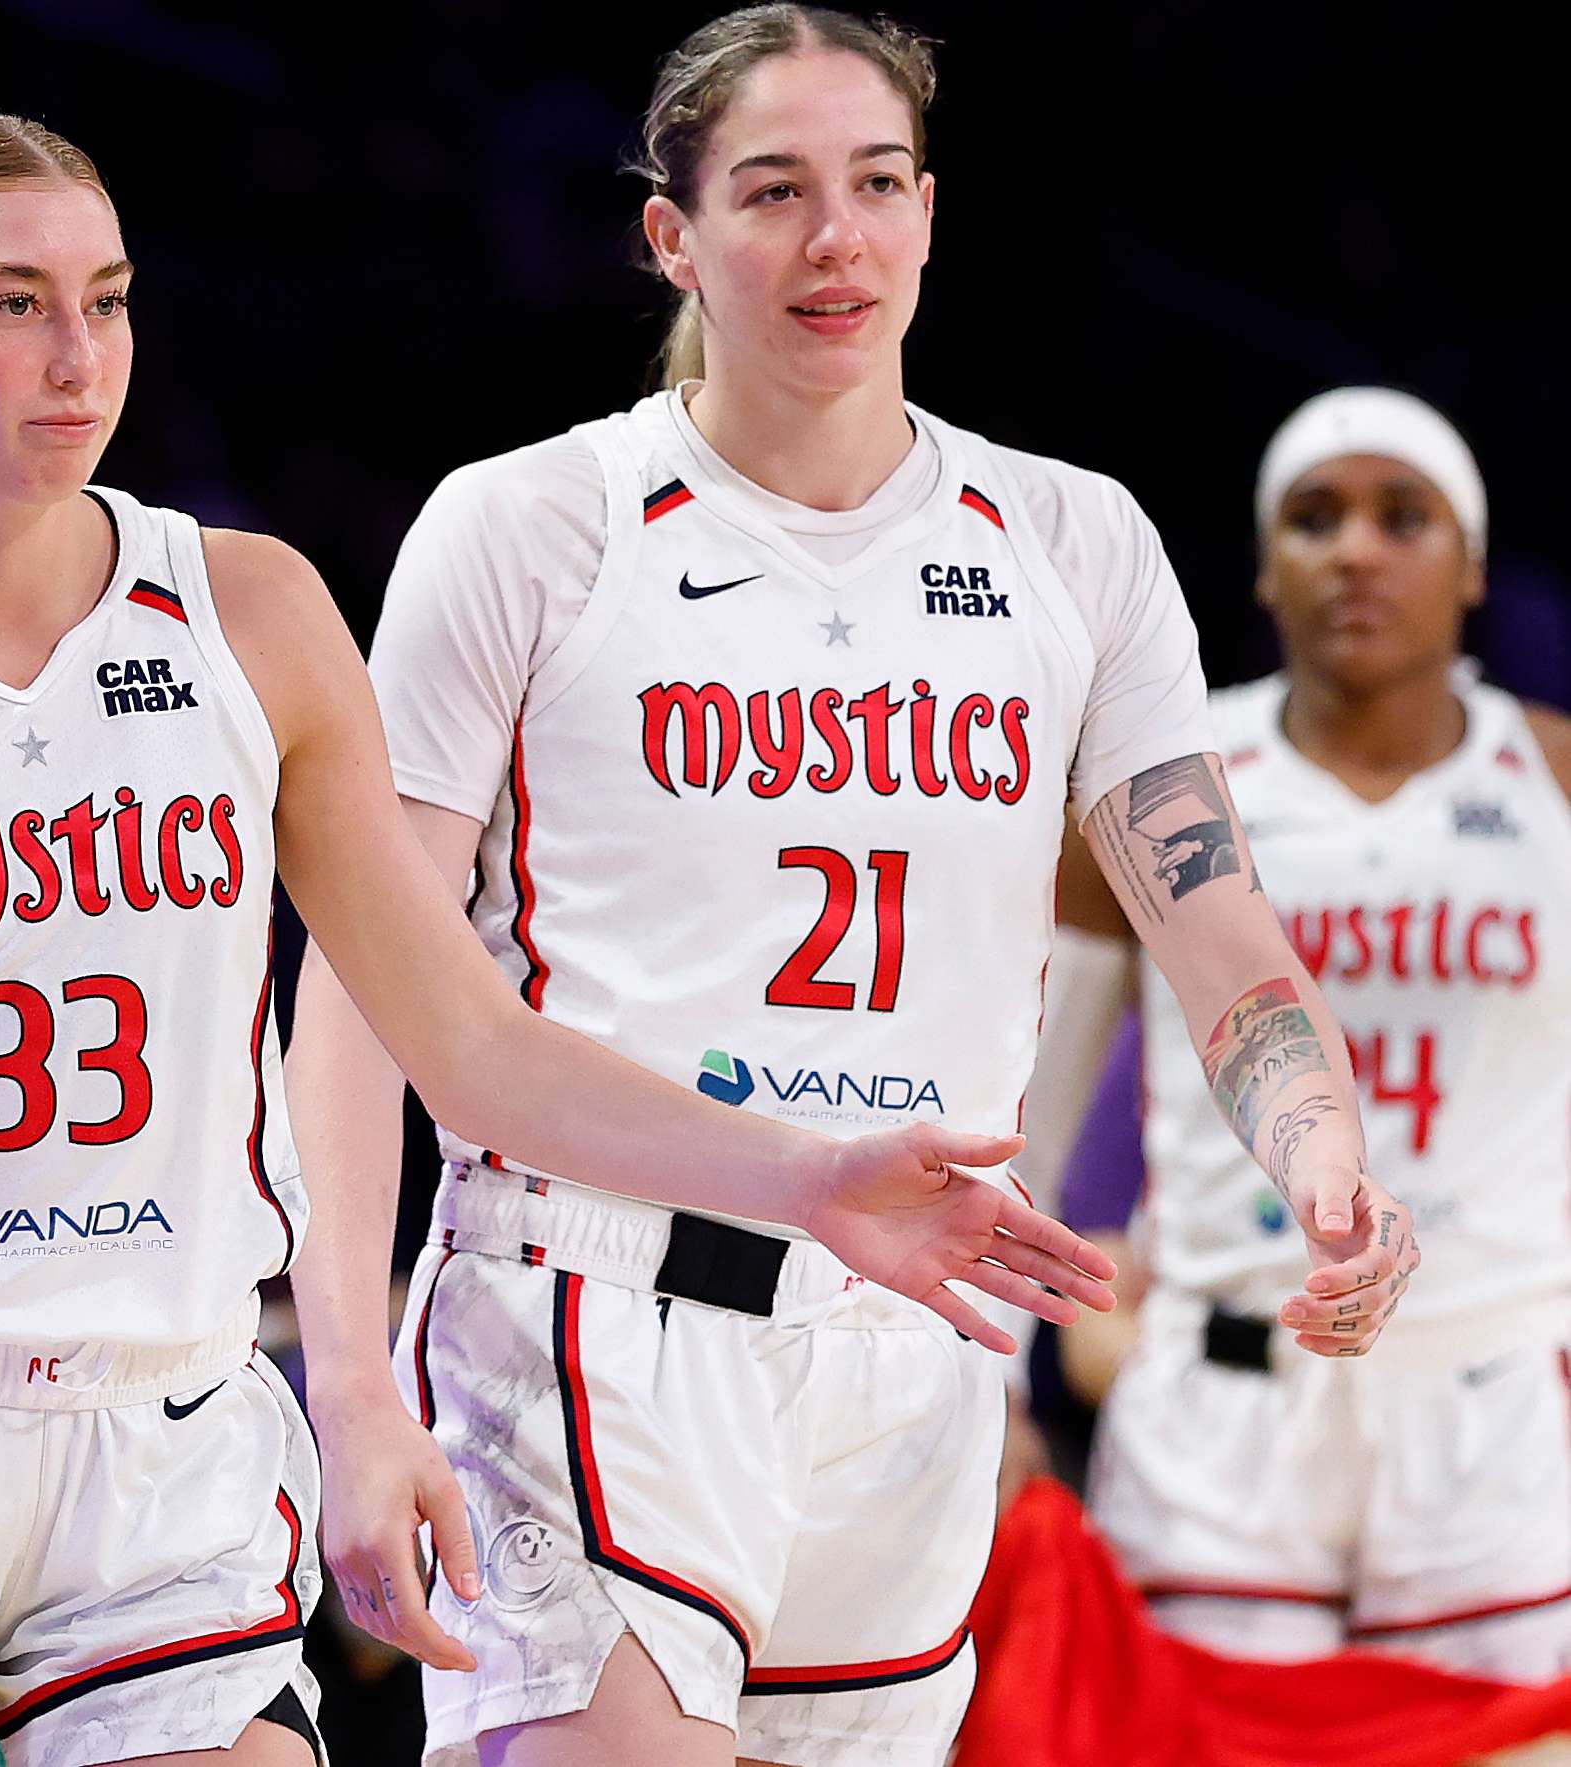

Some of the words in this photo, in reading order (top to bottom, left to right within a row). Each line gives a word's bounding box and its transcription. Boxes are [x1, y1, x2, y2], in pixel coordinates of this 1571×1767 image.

[920, 563, 991, 591] CAR
[926, 589, 1012, 619] max
[96, 658, 174, 688] CAR
[103, 680, 199, 718] max
[764, 845, 910, 1013] 21
[1287, 897, 1540, 987] ystics
[762, 1066, 945, 1114] VANDA
[1346, 1030, 1441, 1154] 4
